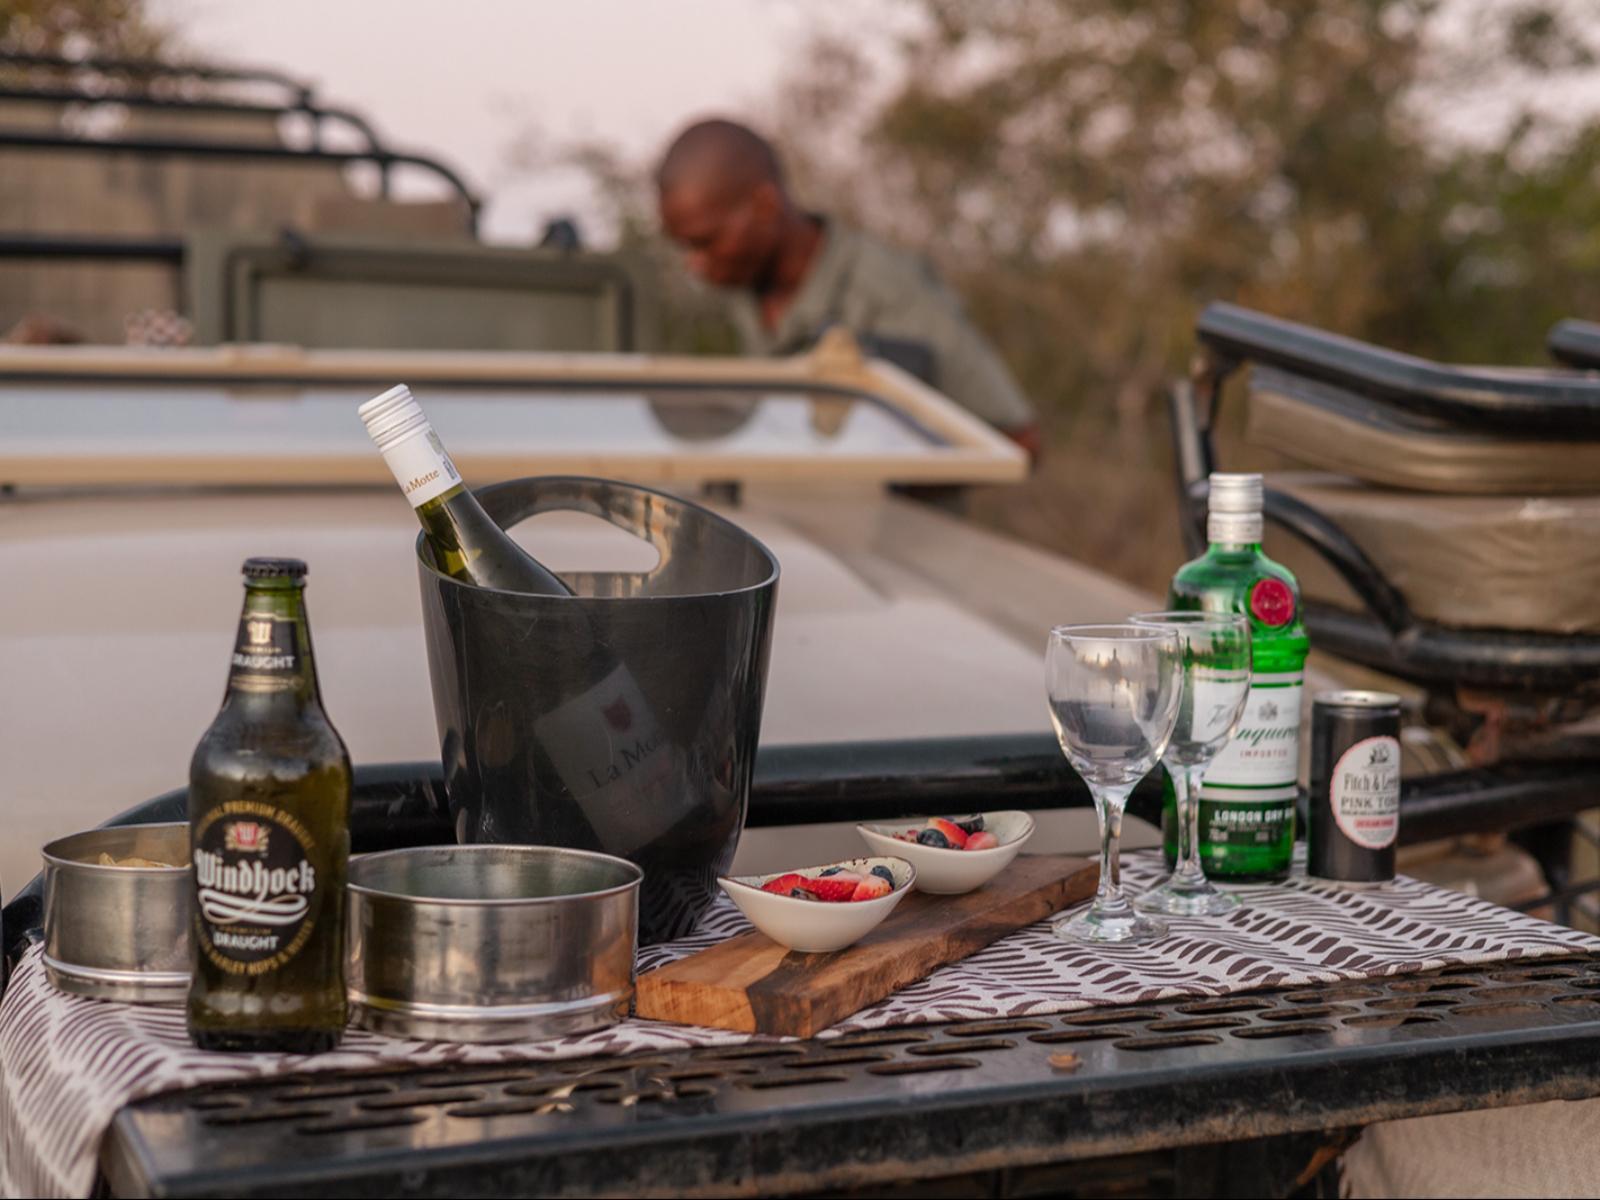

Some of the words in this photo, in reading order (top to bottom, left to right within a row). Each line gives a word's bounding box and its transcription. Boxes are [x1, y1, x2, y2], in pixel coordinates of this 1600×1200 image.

[410, 470, 440, 491] Motte
[1344, 773, 1370, 791] Fitch
[1373, 774, 1380, 791] &
[1341, 796, 1373, 809] PINK
[1214, 809, 1262, 823] LONDON
[1264, 809, 1283, 822] DRY
[213, 931, 279, 950] DRAUGHT
